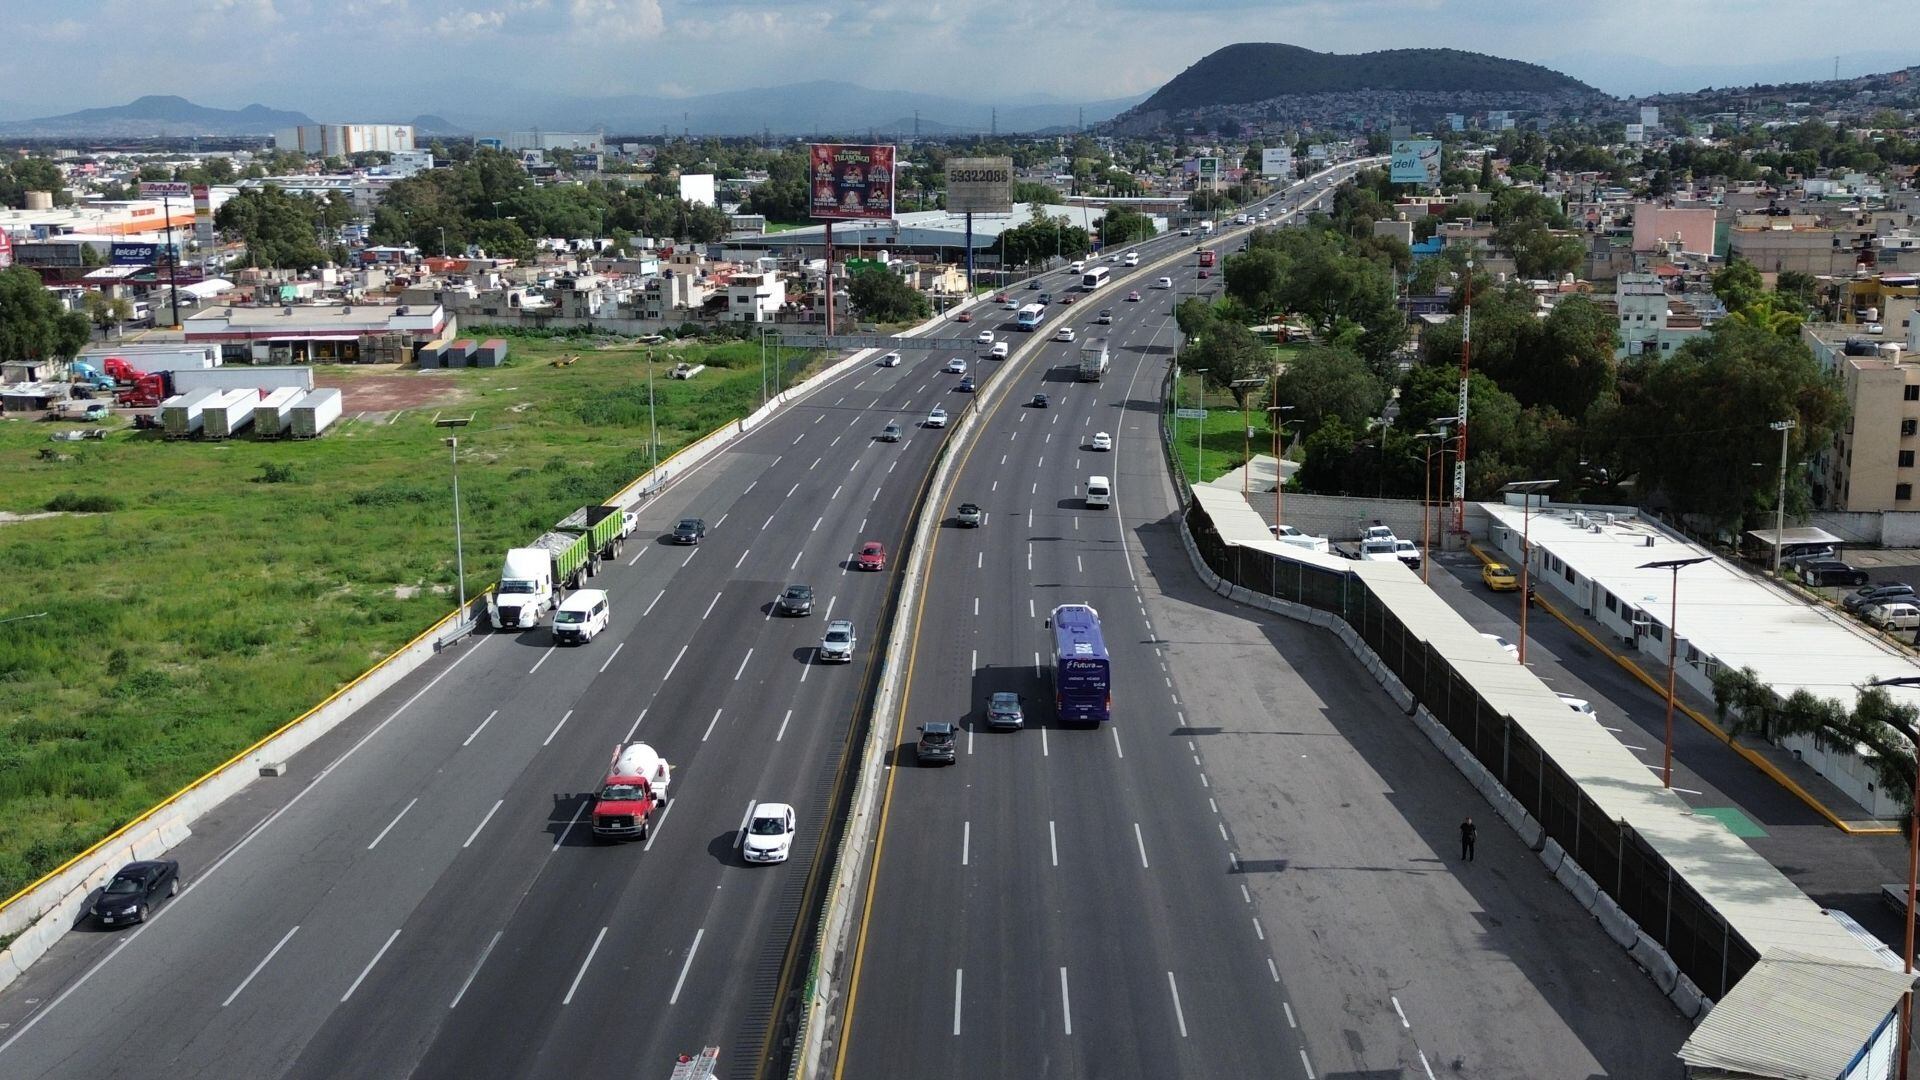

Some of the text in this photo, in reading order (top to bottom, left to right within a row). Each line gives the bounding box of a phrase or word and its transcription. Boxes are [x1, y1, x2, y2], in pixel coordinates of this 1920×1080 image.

[115, 248, 151, 256] telcel 5G
[1073, 661, 1096, 669] Futura
